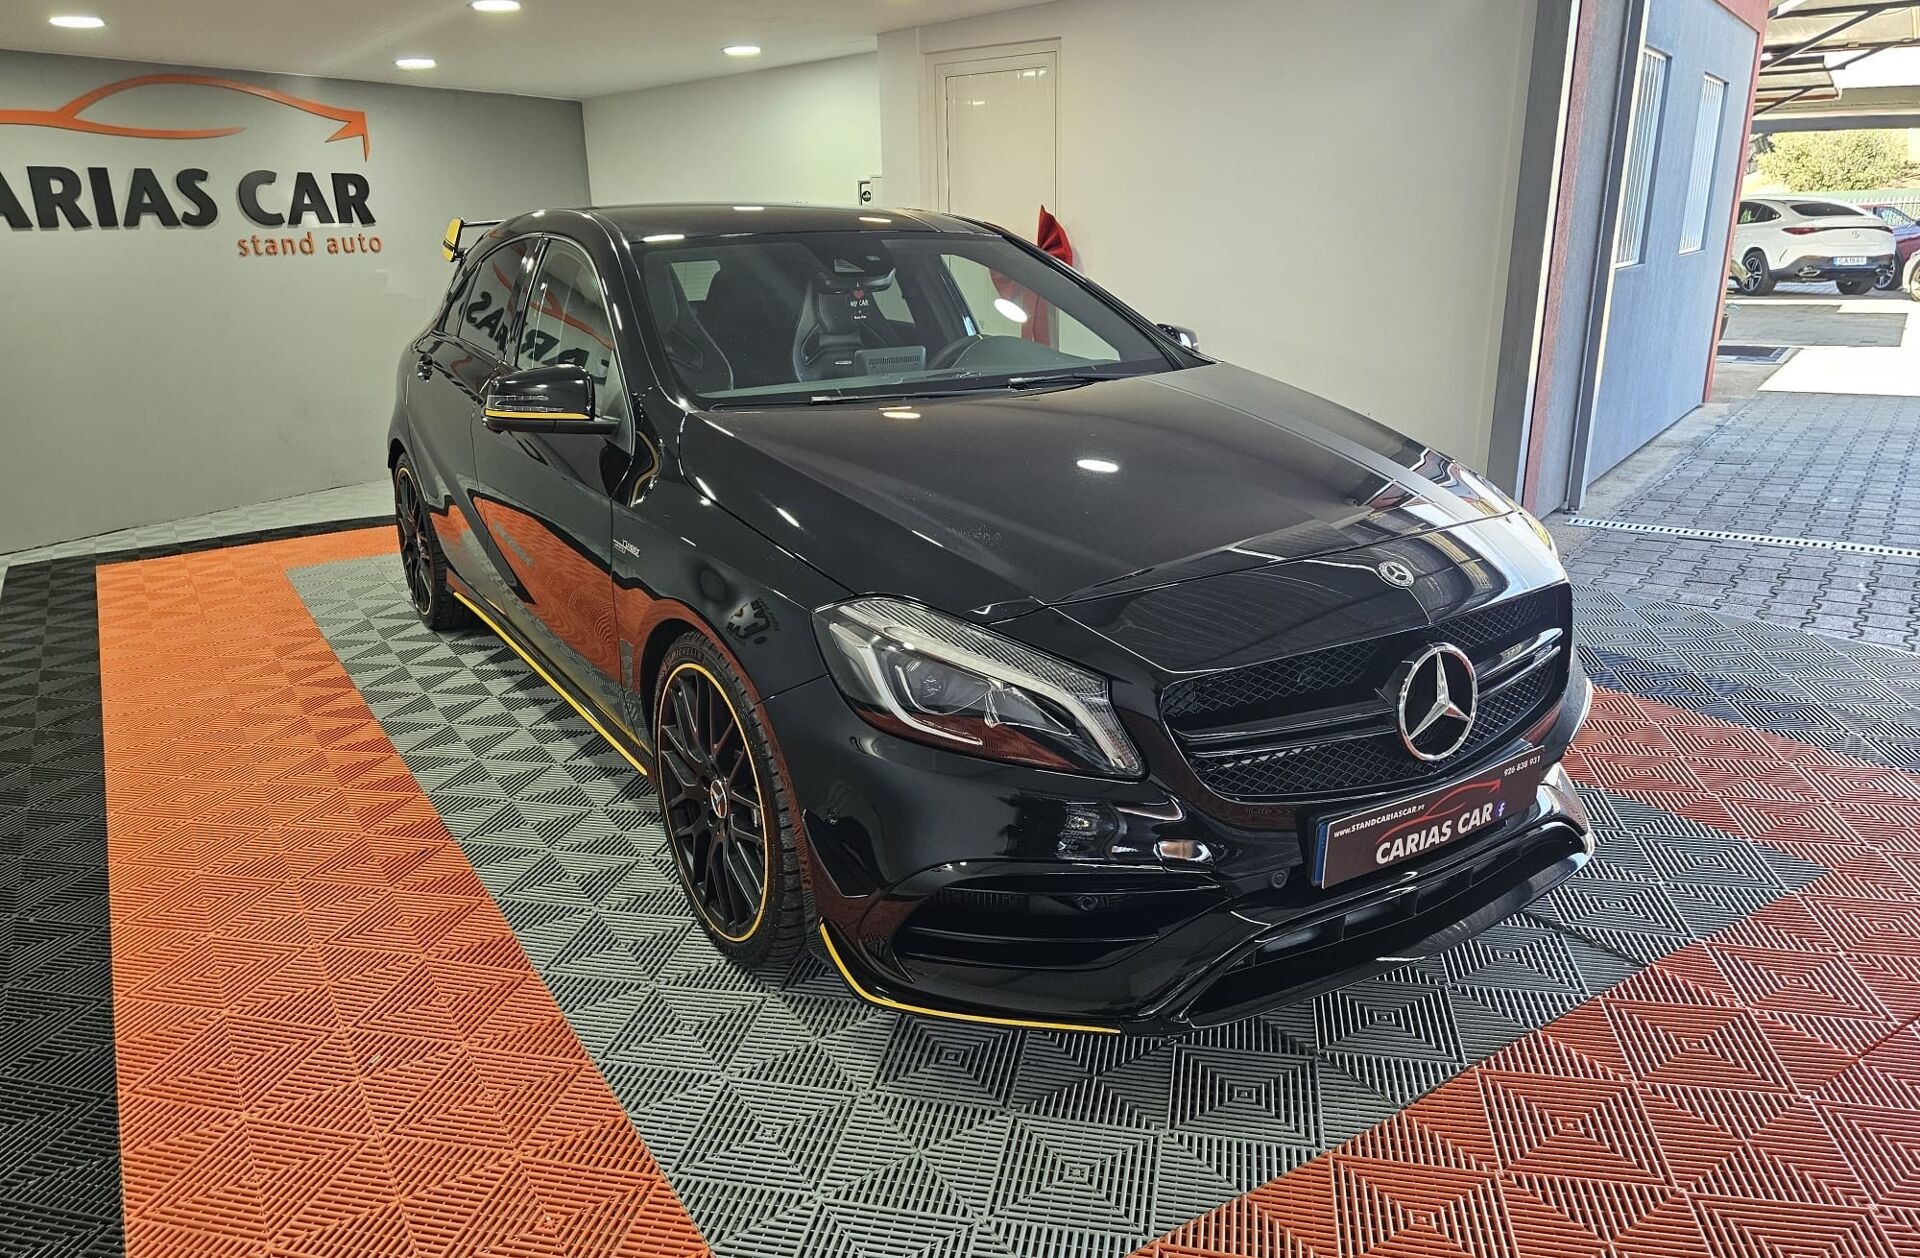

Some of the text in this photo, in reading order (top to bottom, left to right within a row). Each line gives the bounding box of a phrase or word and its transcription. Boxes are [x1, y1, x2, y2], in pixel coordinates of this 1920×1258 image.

[238, 170, 377, 227] CAR
[237, 231, 383, 257] stand auto
[1529, 755, 1541, 766] 931
[1375, 820, 1453, 865] CARIAS
[1457, 802, 1493, 834] CAR
